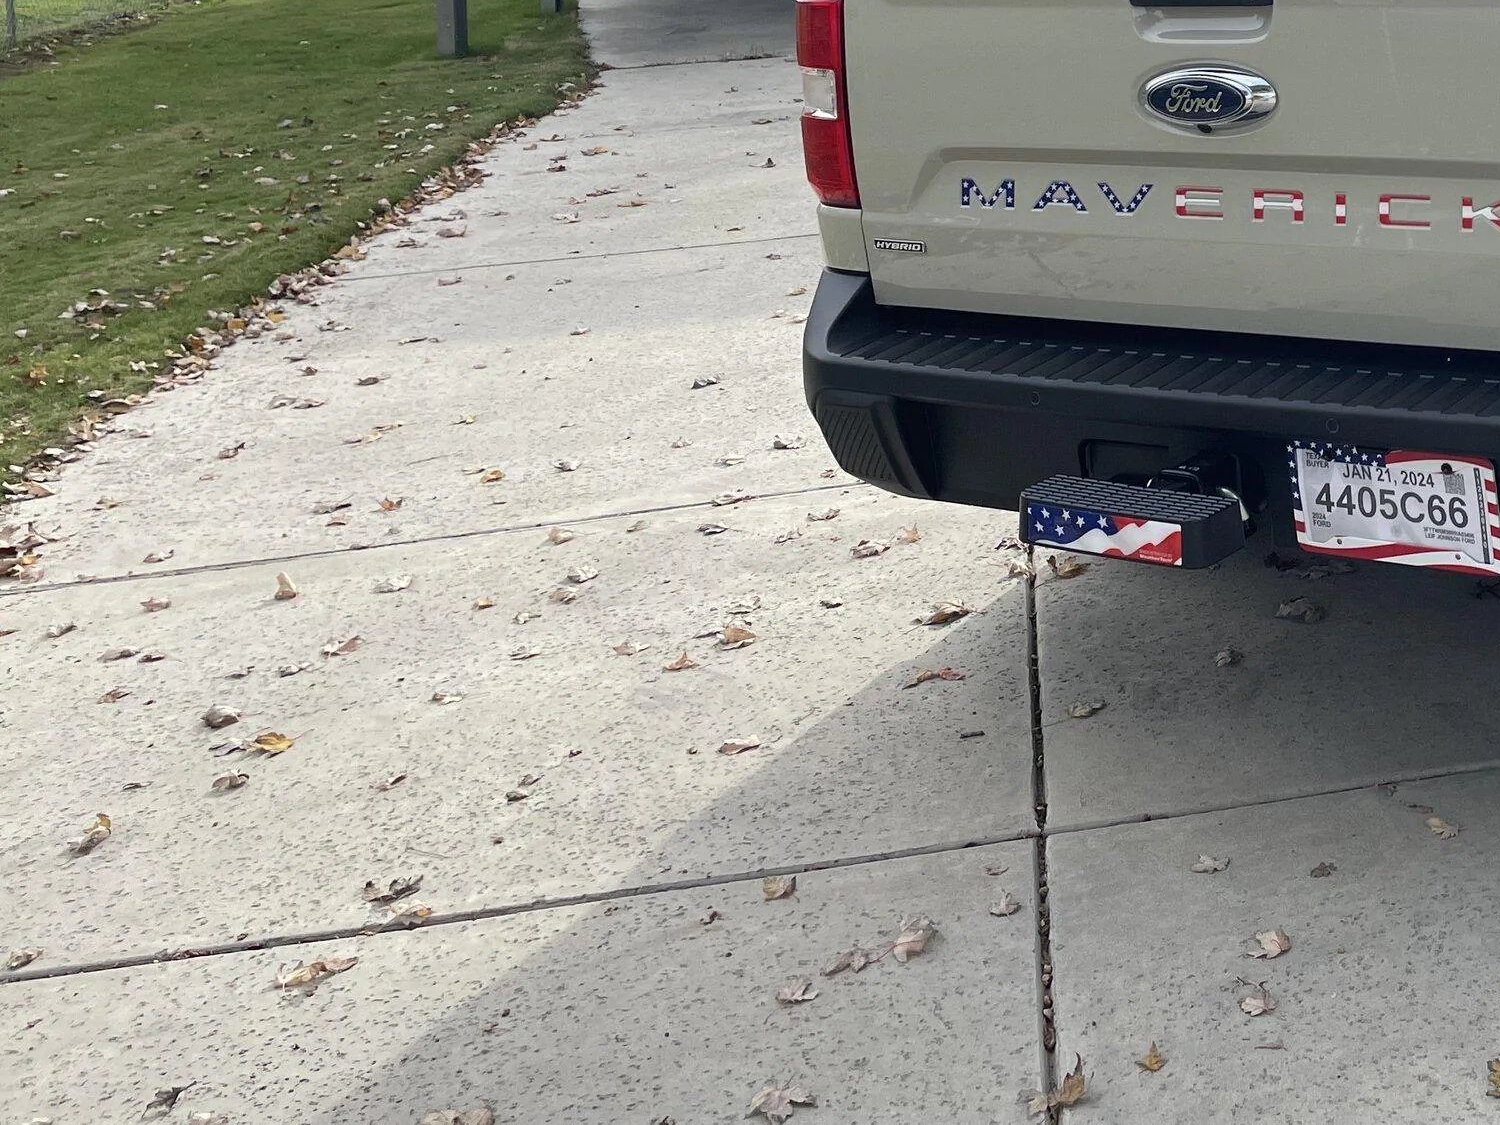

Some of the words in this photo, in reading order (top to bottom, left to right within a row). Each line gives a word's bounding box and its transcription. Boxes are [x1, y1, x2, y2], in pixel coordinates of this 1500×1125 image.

[1165, 83, 1222, 113] Ford
[877, 241, 921, 251] HYBRID
[1306, 460, 1330, 469] BUYER
[1342, 463, 1372, 480] JAN
[1375, 467, 1397, 486] 21,
[1400, 470, 1434, 488] 2024
[1315, 482, 1469, 528] 4405C66
[1313, 519, 1331, 527] FORD
